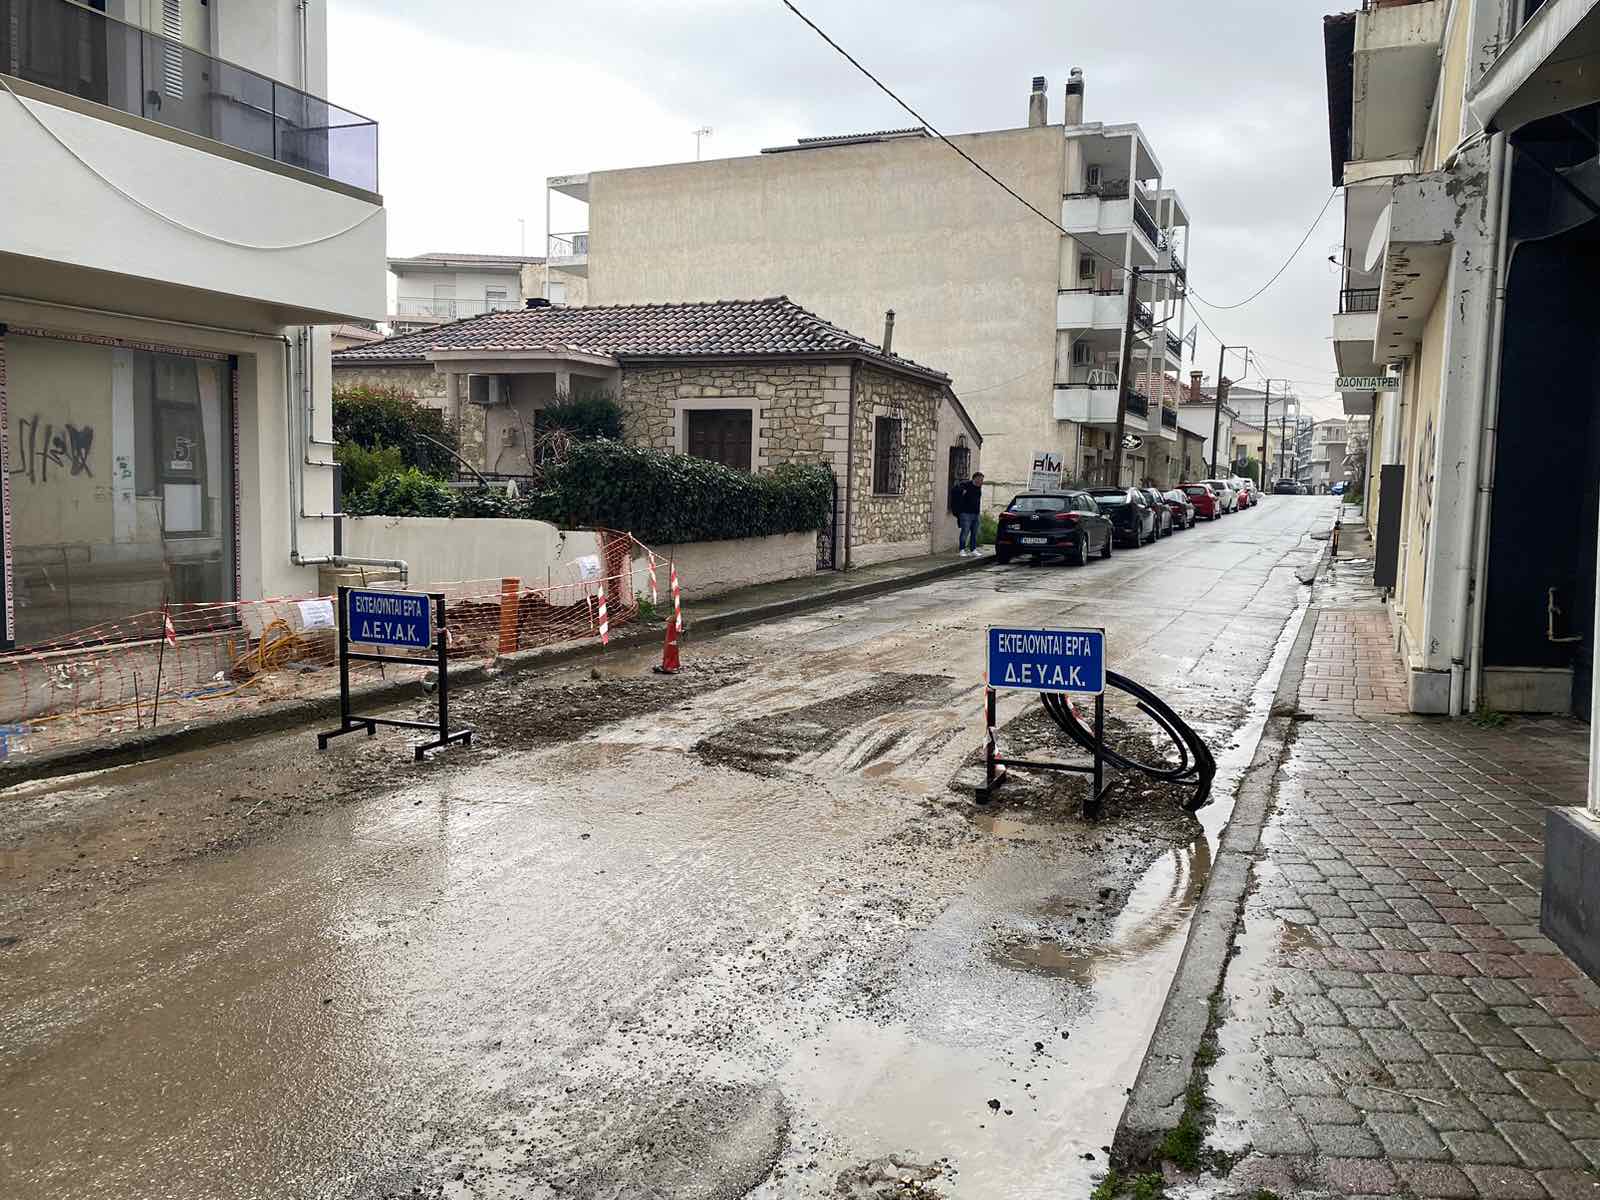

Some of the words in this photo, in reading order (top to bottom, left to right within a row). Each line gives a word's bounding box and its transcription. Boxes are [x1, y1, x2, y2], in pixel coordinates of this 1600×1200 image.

[355, 596, 402, 616] ΕΚΤΕΛΟΥΝΤΑΙ
[403, 600, 422, 617] ΕΡΓΑ
[361, 620, 420, 642] Δ.Ε.Υ.Α.Κ.
[998, 633, 1063, 655] ΕΚΤΕΛΟΥΝΤΑΙ
[1065, 636, 1092, 657] ΕΡΓΑ
